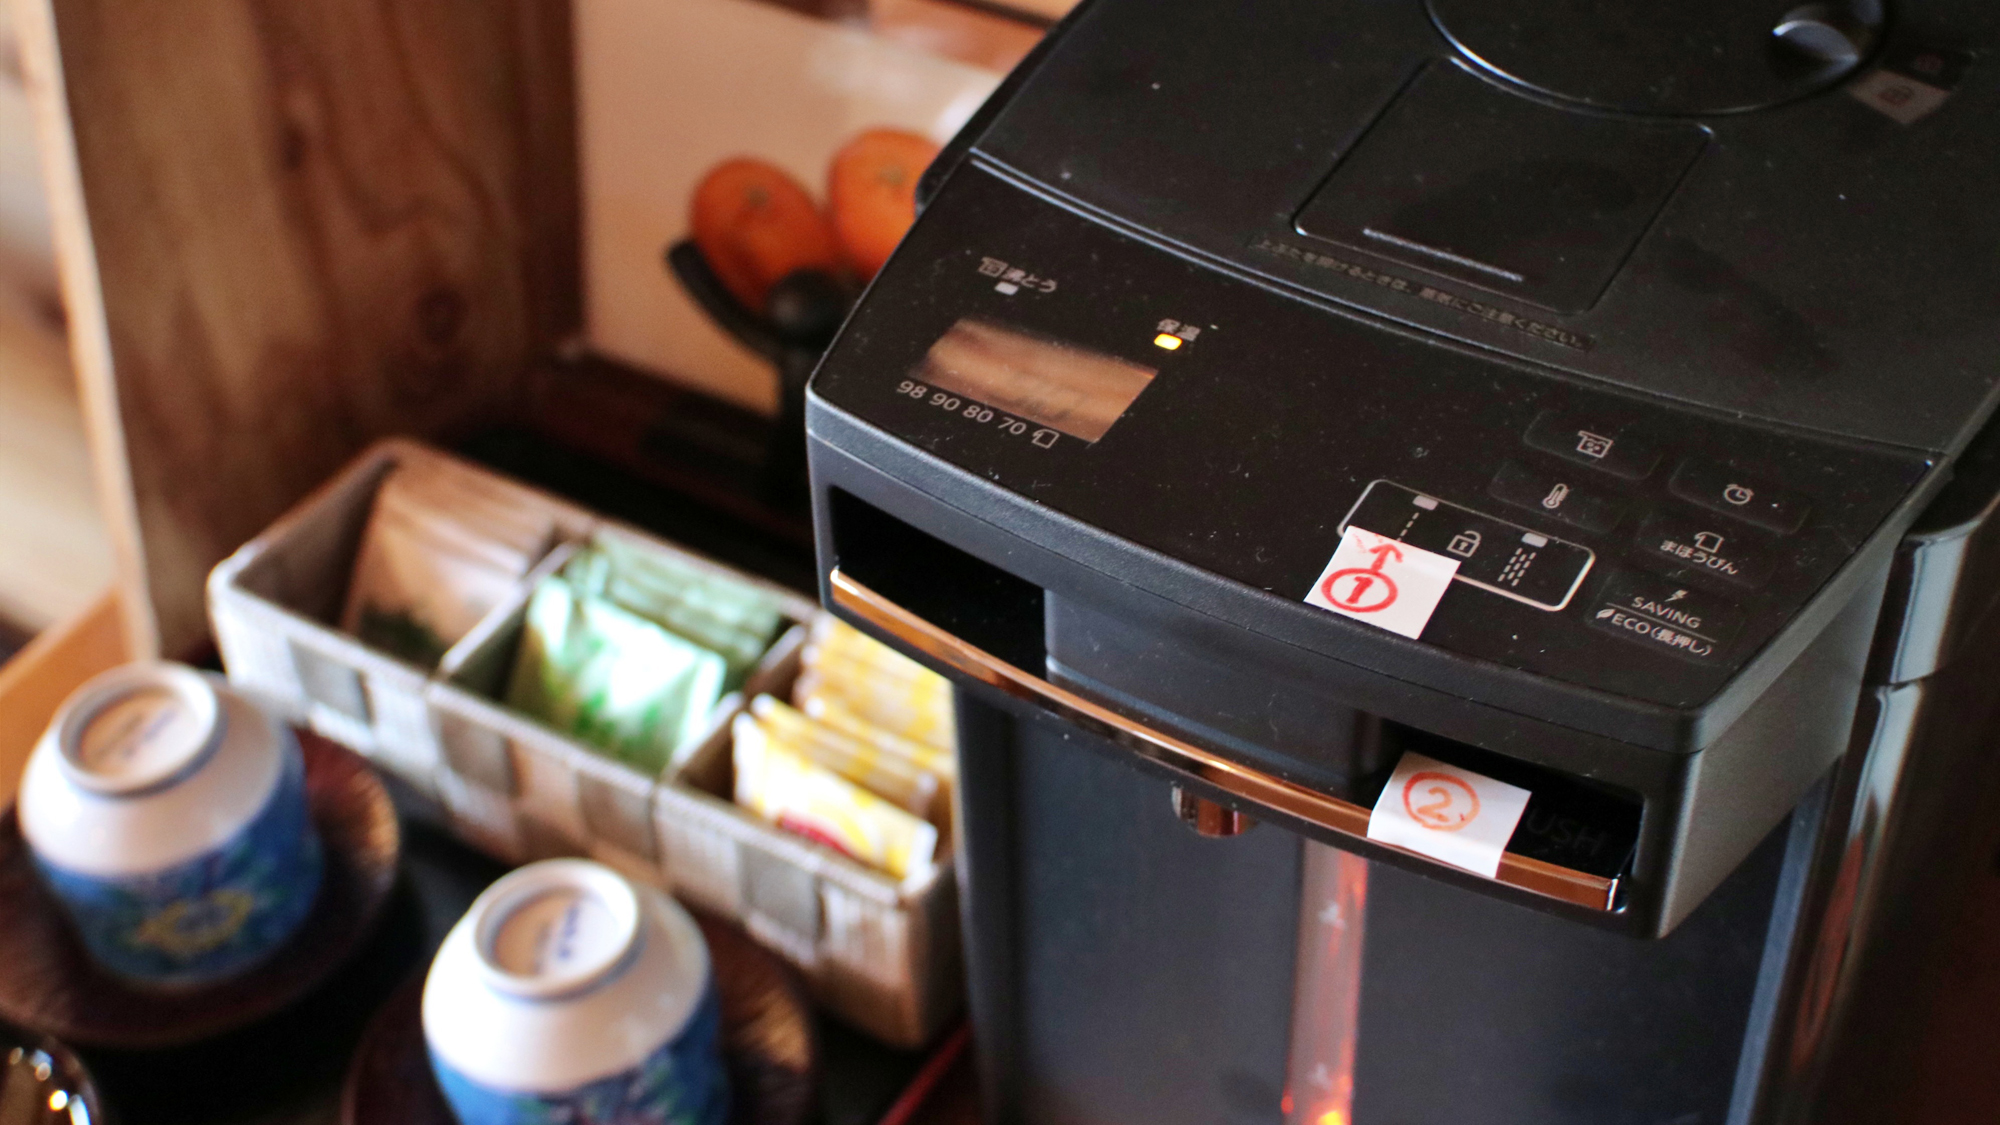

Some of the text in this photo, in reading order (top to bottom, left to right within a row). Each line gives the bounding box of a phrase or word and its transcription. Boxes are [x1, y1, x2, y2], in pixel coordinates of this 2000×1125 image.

[896, 380, 1027, 436] 98 90 80 70
[1660, 539, 1739, 576] まほうびん
[1631, 596, 1702, 630] SAVING
[1526, 807, 1608, 856] USH
